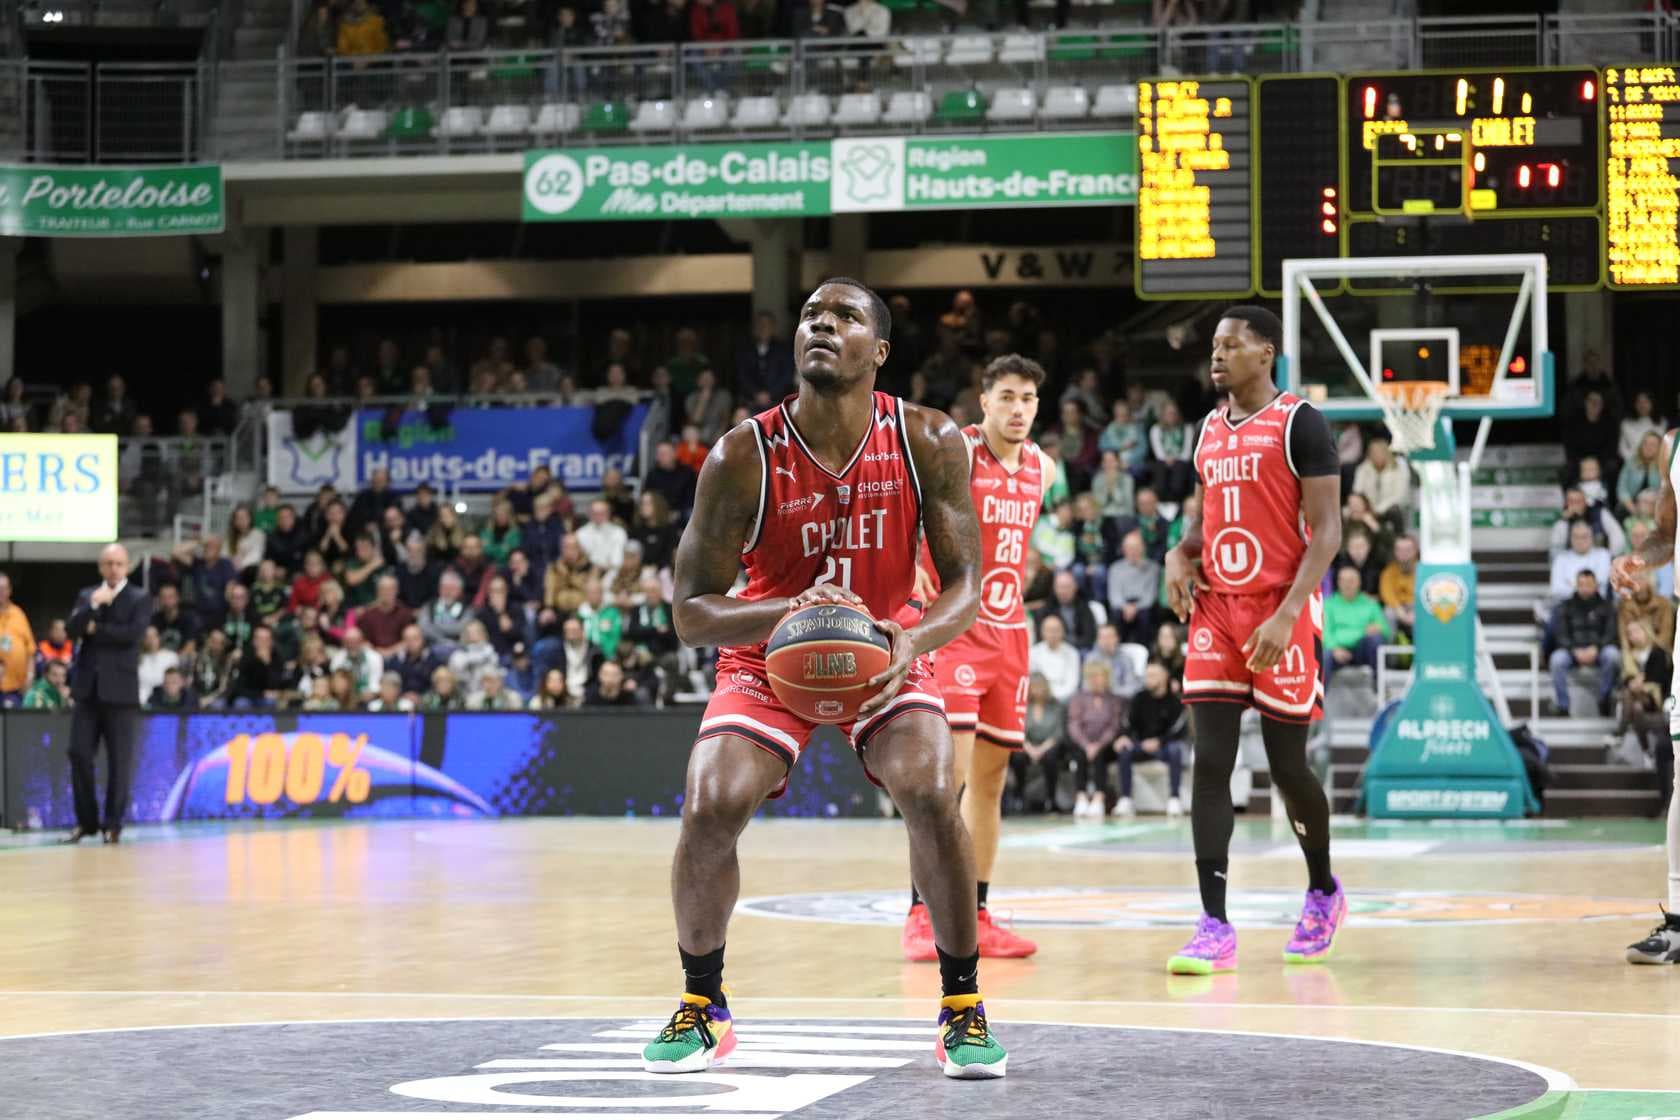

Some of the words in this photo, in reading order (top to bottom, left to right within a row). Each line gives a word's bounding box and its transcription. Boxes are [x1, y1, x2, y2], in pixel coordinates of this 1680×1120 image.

[586, 151, 829, 187] Pas-de-Calais
[908, 145, 987, 171] Région
[24, 175, 215, 209] Porteloise
[535, 169, 573, 197] 62
[661, 190, 804, 216] Département
[40, 216, 110, 228] TRAITEUR
[981, 253, 1006, 279] V
[1017, 252, 1043, 278] &
[1056, 252, 1094, 278] W
[1203, 452, 1263, 488] CHOLET
[982, 495, 1037, 529] CHOLET
[1222, 486, 1241, 523] 11
[801, 508, 888, 558] CHOLET
[995, 528, 1023, 565] 26
[814, 556, 852, 590] 21
[787, 616, 873, 641] SPALDING
[815, 651, 857, 679] LNB
[224, 732, 372, 804] 100%
